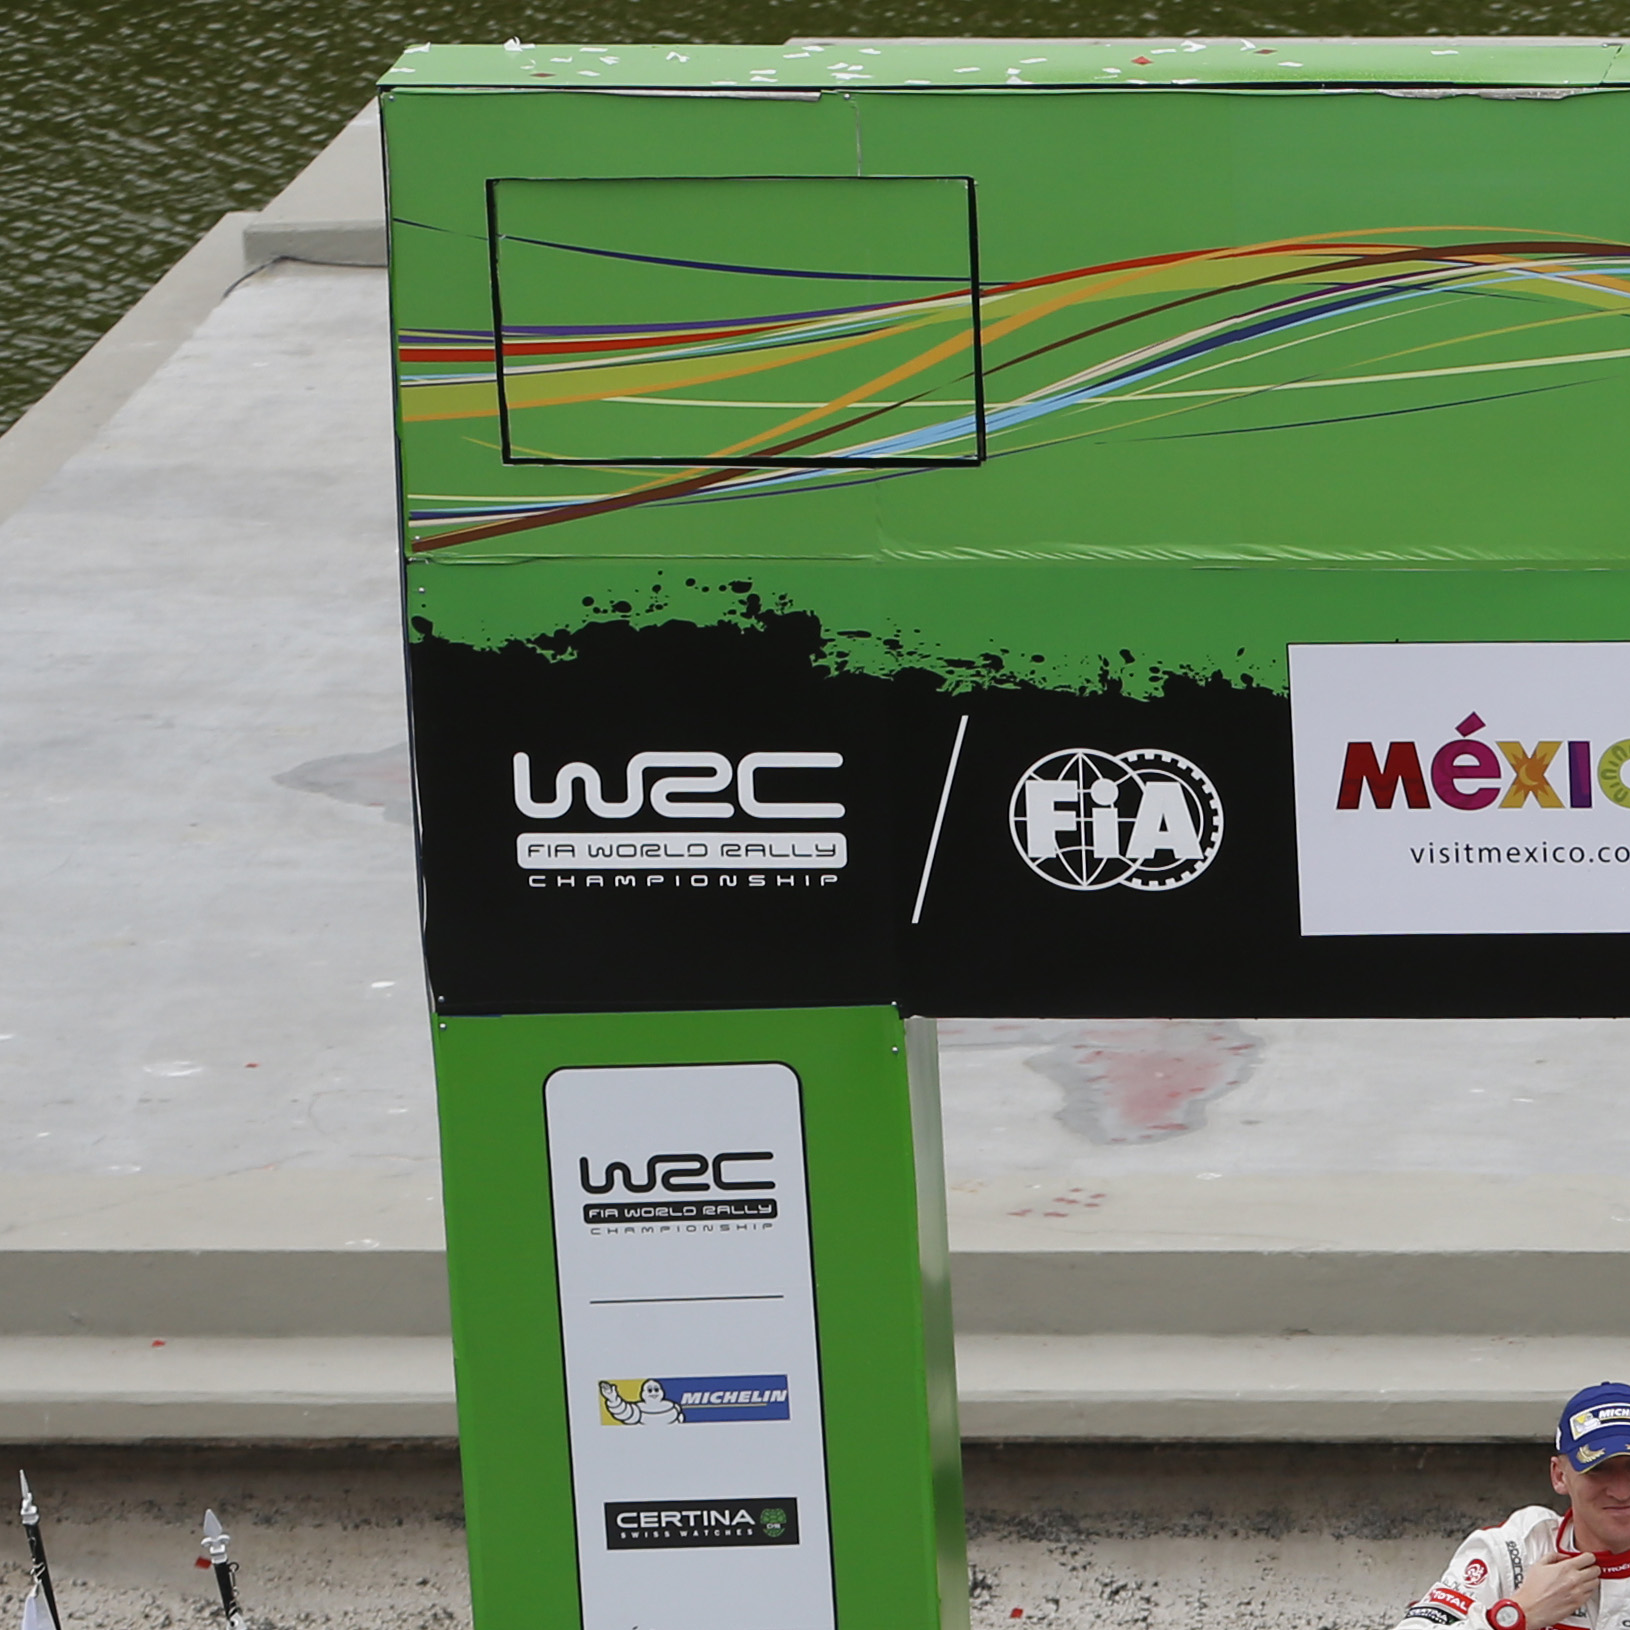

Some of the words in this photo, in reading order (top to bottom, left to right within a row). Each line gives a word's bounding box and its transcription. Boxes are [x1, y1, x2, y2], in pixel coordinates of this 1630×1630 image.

[512, 751, 846, 819] WRC
[527, 844, 575, 858] FIA
[586, 844, 709, 858] WORLD
[721, 844, 837, 859] RALLY
[528, 875, 839, 888] CHAMPIONSHIP
[579, 1151, 776, 1194] WRC
[589, 1207, 619, 1219] FIA
[624, 1205, 697, 1218] WORLD
[703, 1203, 773, 1216] RALLY
[590, 1223, 774, 1235] CHAMPIONSHIP
[680, 1388, 788, 1406] MICHELIN
[616, 1509, 756, 1528] CERTINA
[621, 1530, 670, 1539] SWISS
[680, 1529, 753, 1538] WATCHES
